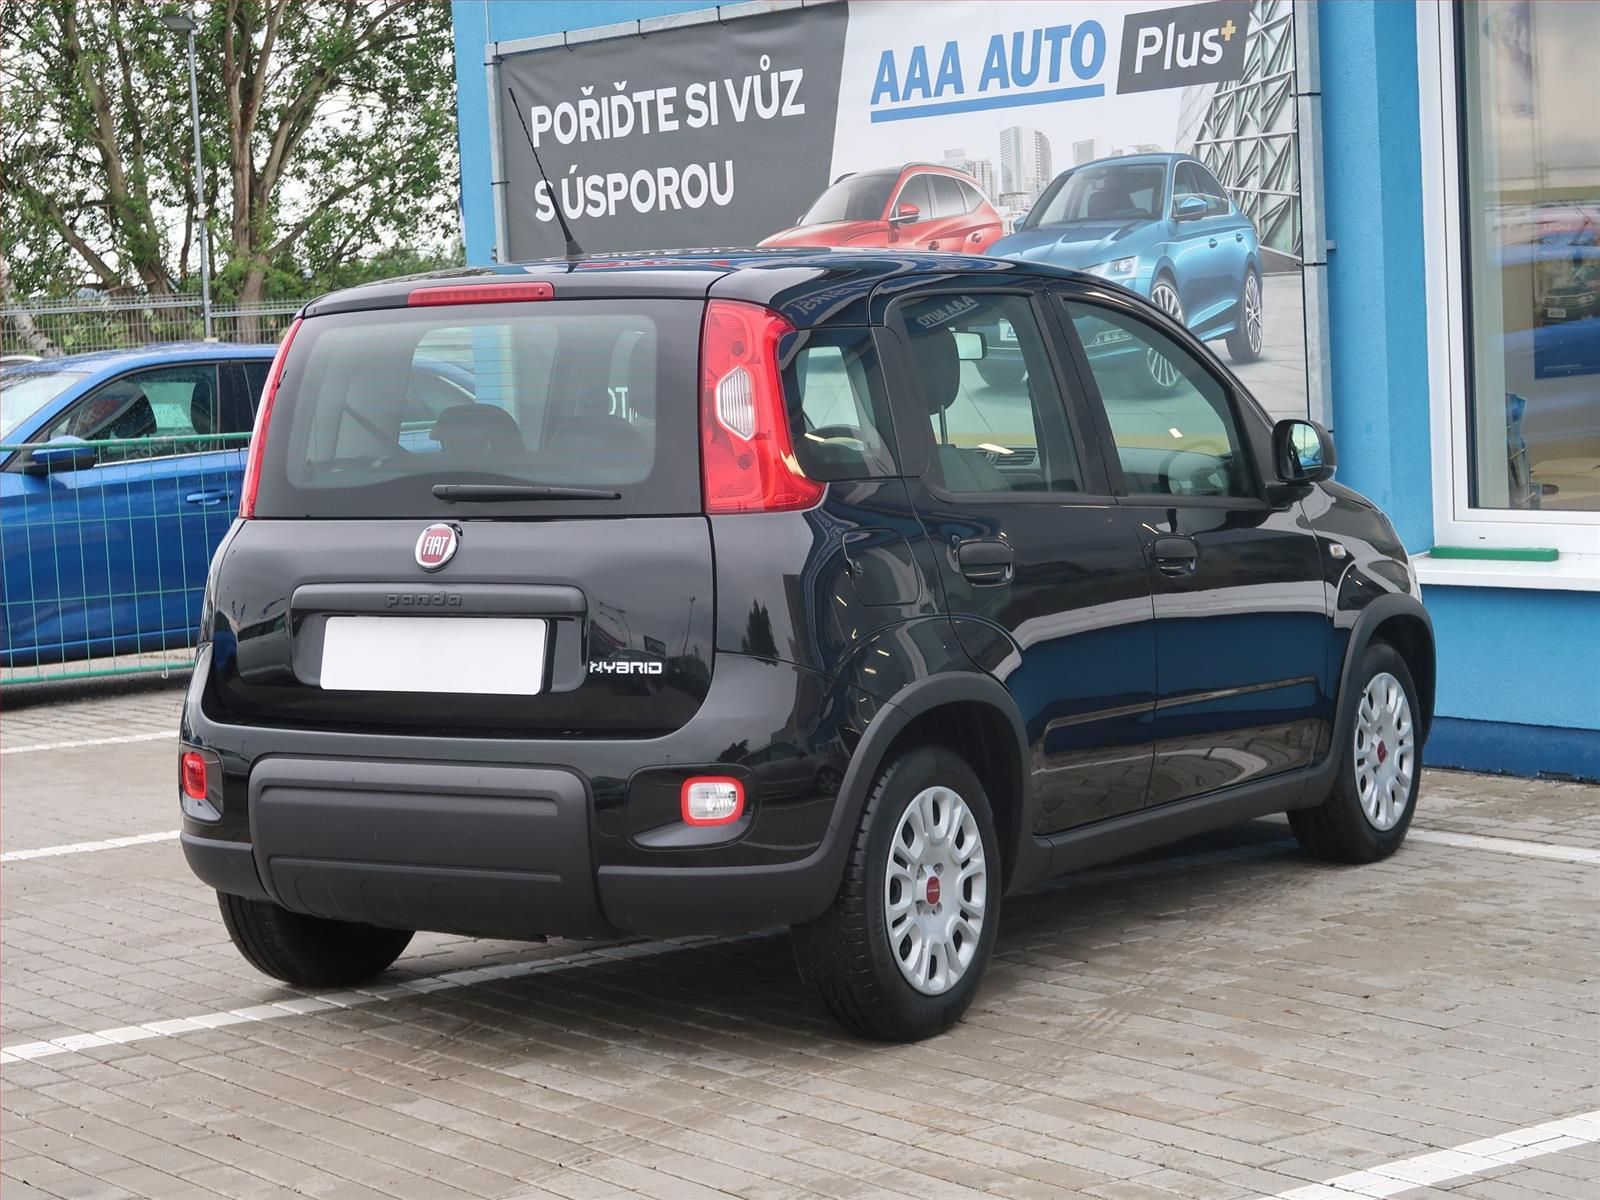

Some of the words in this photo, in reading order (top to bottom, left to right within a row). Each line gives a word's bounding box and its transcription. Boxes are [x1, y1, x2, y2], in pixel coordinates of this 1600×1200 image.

[870, 40, 965, 106] AAA
[978, 19, 1107, 92] AUTO
[530, 80, 680, 148] POŘIĎTE
[685, 80, 719, 129] SI
[724, 54, 806, 123] VŮZ
[534, 179, 557, 222] S
[560, 160, 735, 220] ÚSPOROU
[422, 535, 449, 556] FIAT
[385, 590, 463, 609] panda
[589, 660, 663, 675] HYBRID
